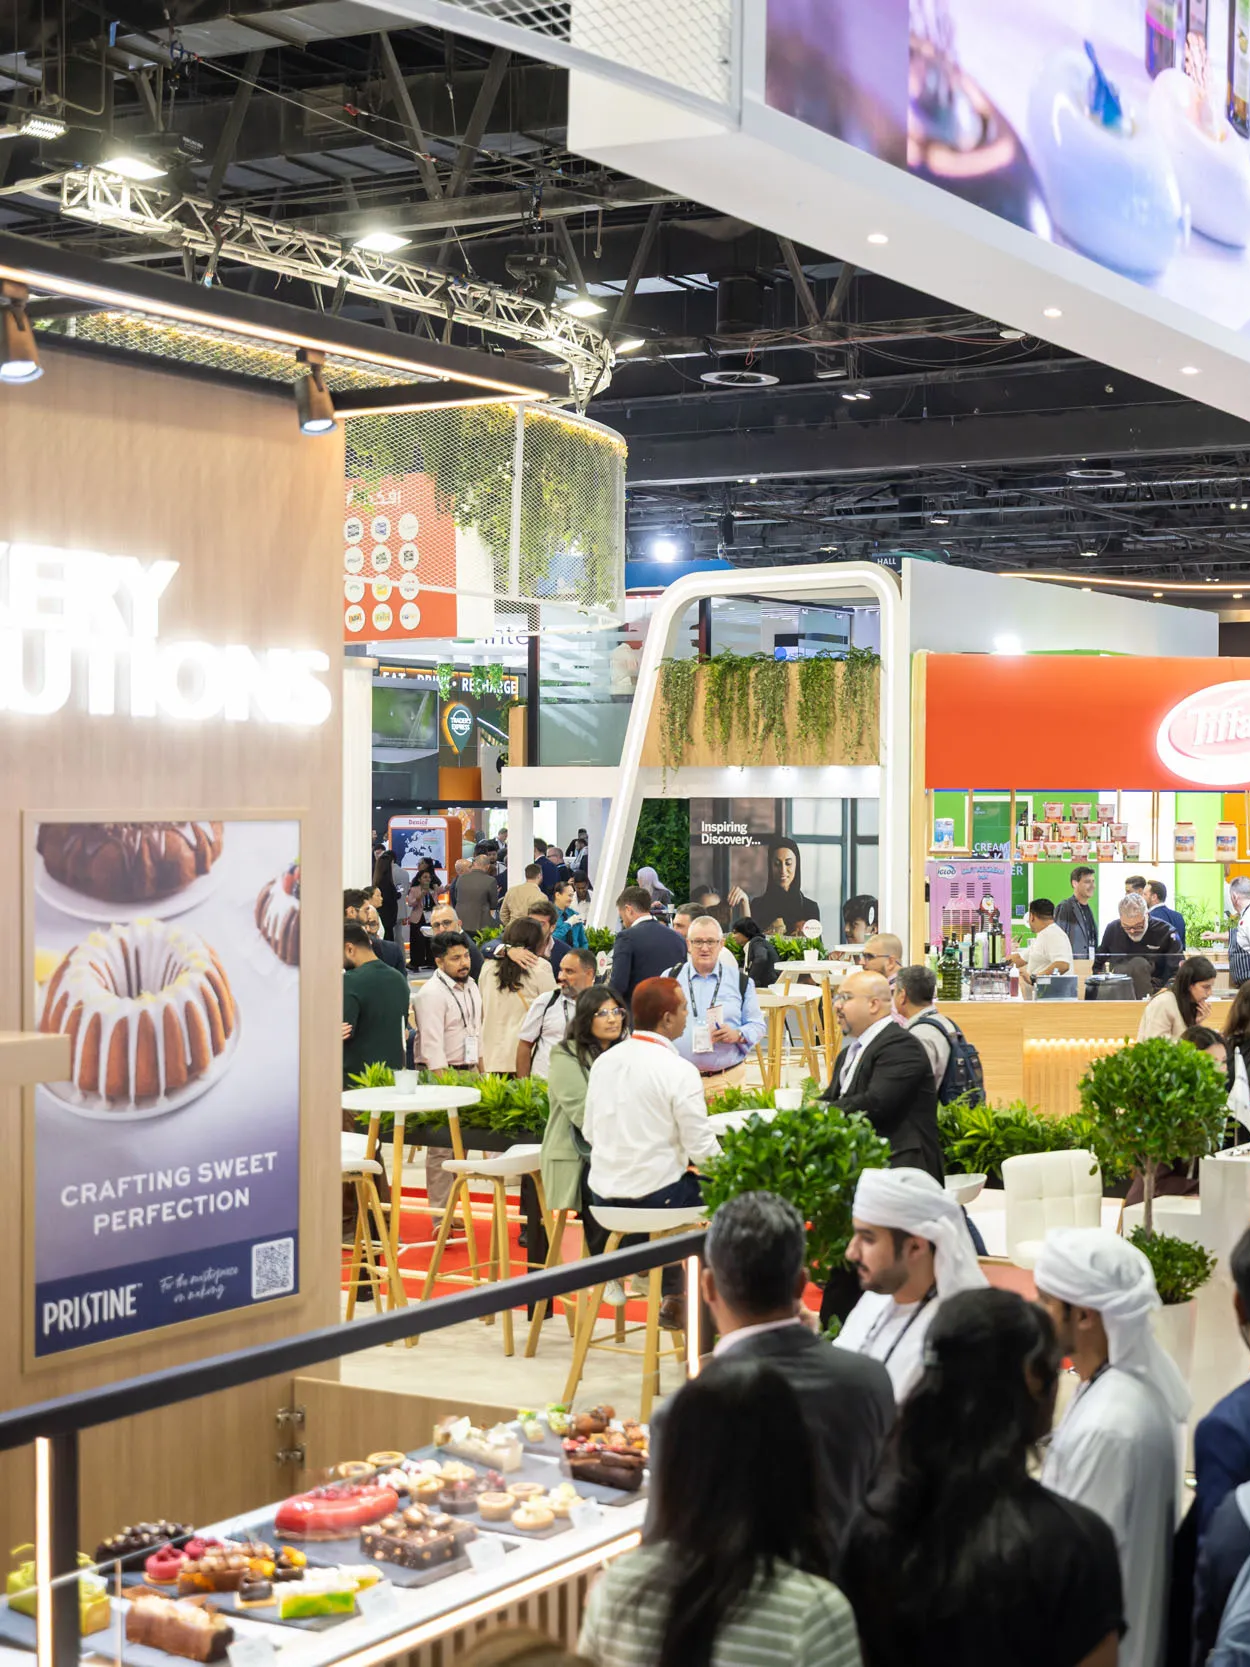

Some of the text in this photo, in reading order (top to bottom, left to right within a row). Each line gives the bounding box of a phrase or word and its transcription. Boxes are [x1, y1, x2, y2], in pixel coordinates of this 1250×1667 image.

[877, 557, 896, 565] HALL
[0, 541, 180, 637] ERY
[0, 626, 332, 725] UTIONS
[701, 821, 747, 834] Inspiring
[701, 833, 761, 848] Discovery...
[974, 842, 1008, 852] CREAM
[1010, 866, 1023, 875] ER
[60, 1151, 278, 1207] CRAFTING SWEET
[93, 1187, 250, 1235] PERFECTION
